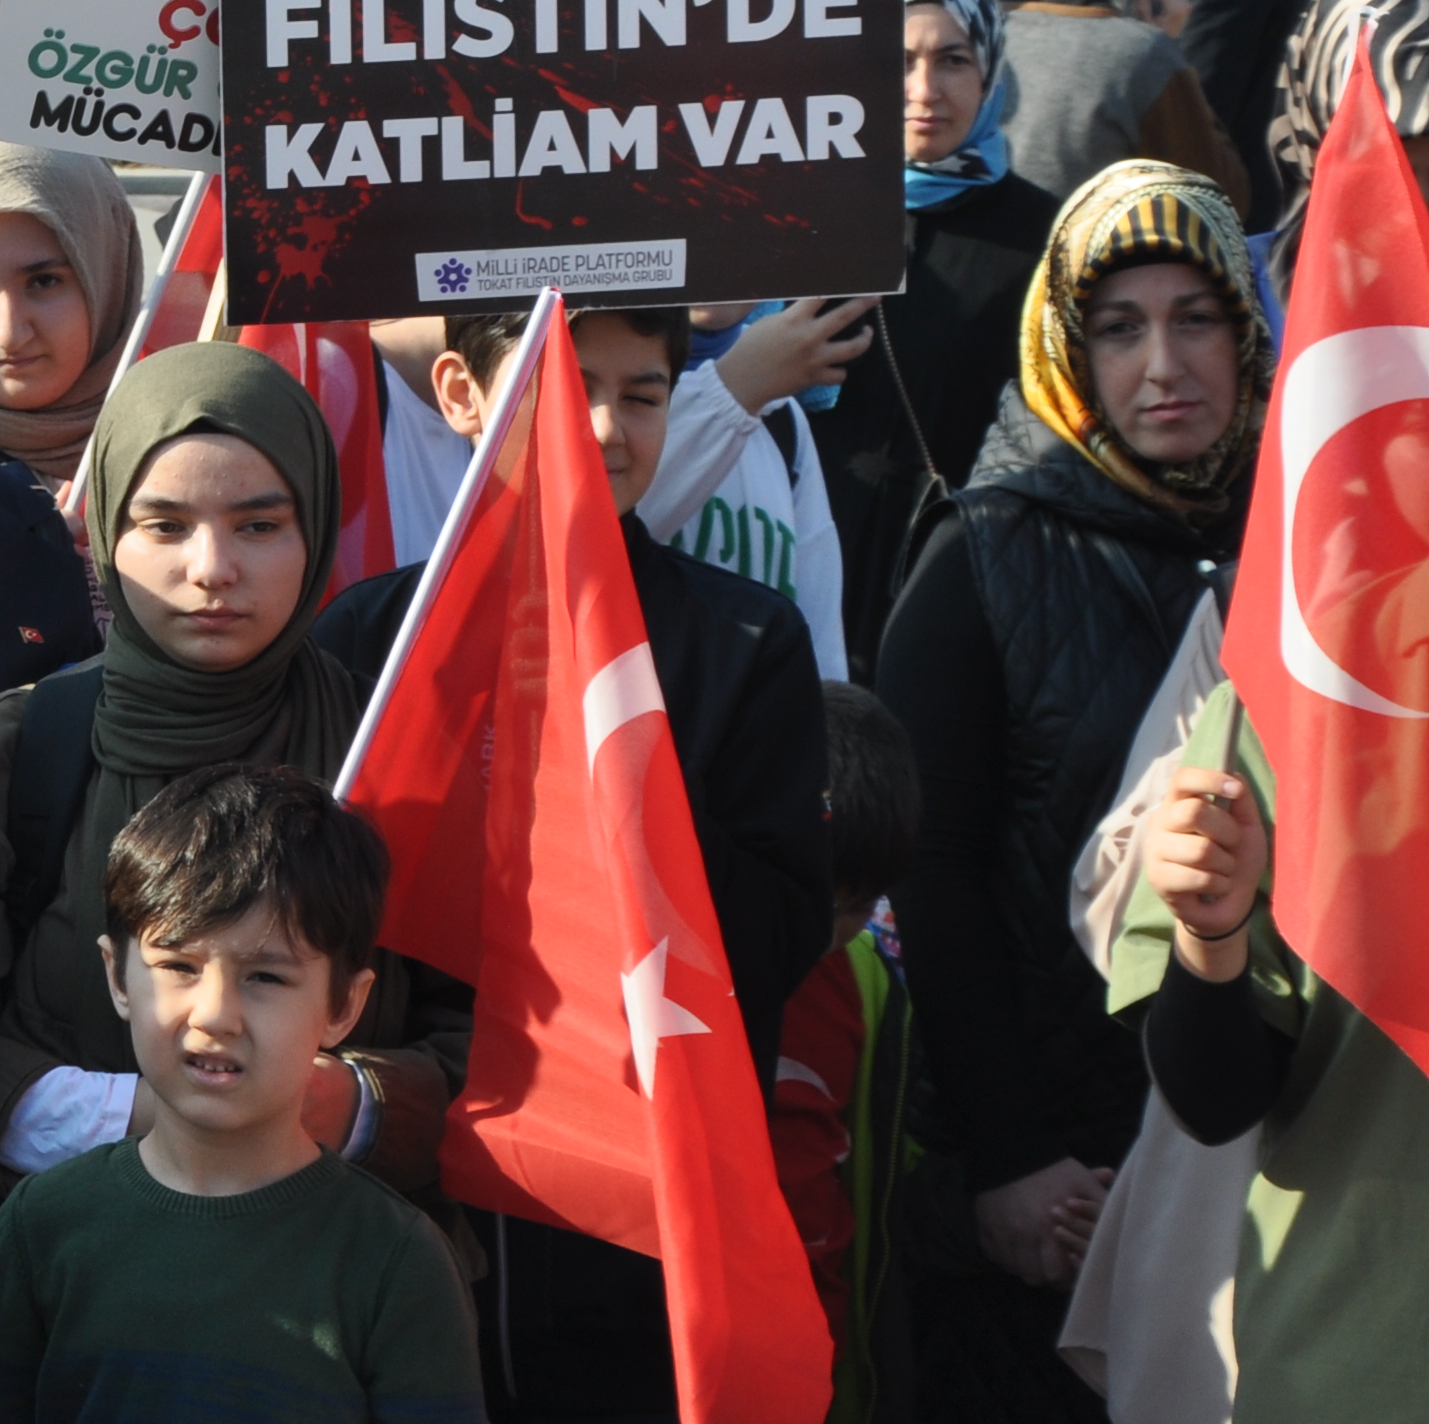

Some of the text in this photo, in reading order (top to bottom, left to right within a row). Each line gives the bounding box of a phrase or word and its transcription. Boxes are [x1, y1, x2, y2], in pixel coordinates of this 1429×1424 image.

[27, 27, 199, 101] ÖZGÜR
[29, 86, 221, 157] MÜCAD
[265, 93, 867, 190] KATLİAM VAR
[477, 278, 513, 292] TOKAT
[563, 272, 630, 288] DAYANIŞMA
[632, 269, 674, 284] GRUBU
[575, 249, 674, 273] PLATFORMU
